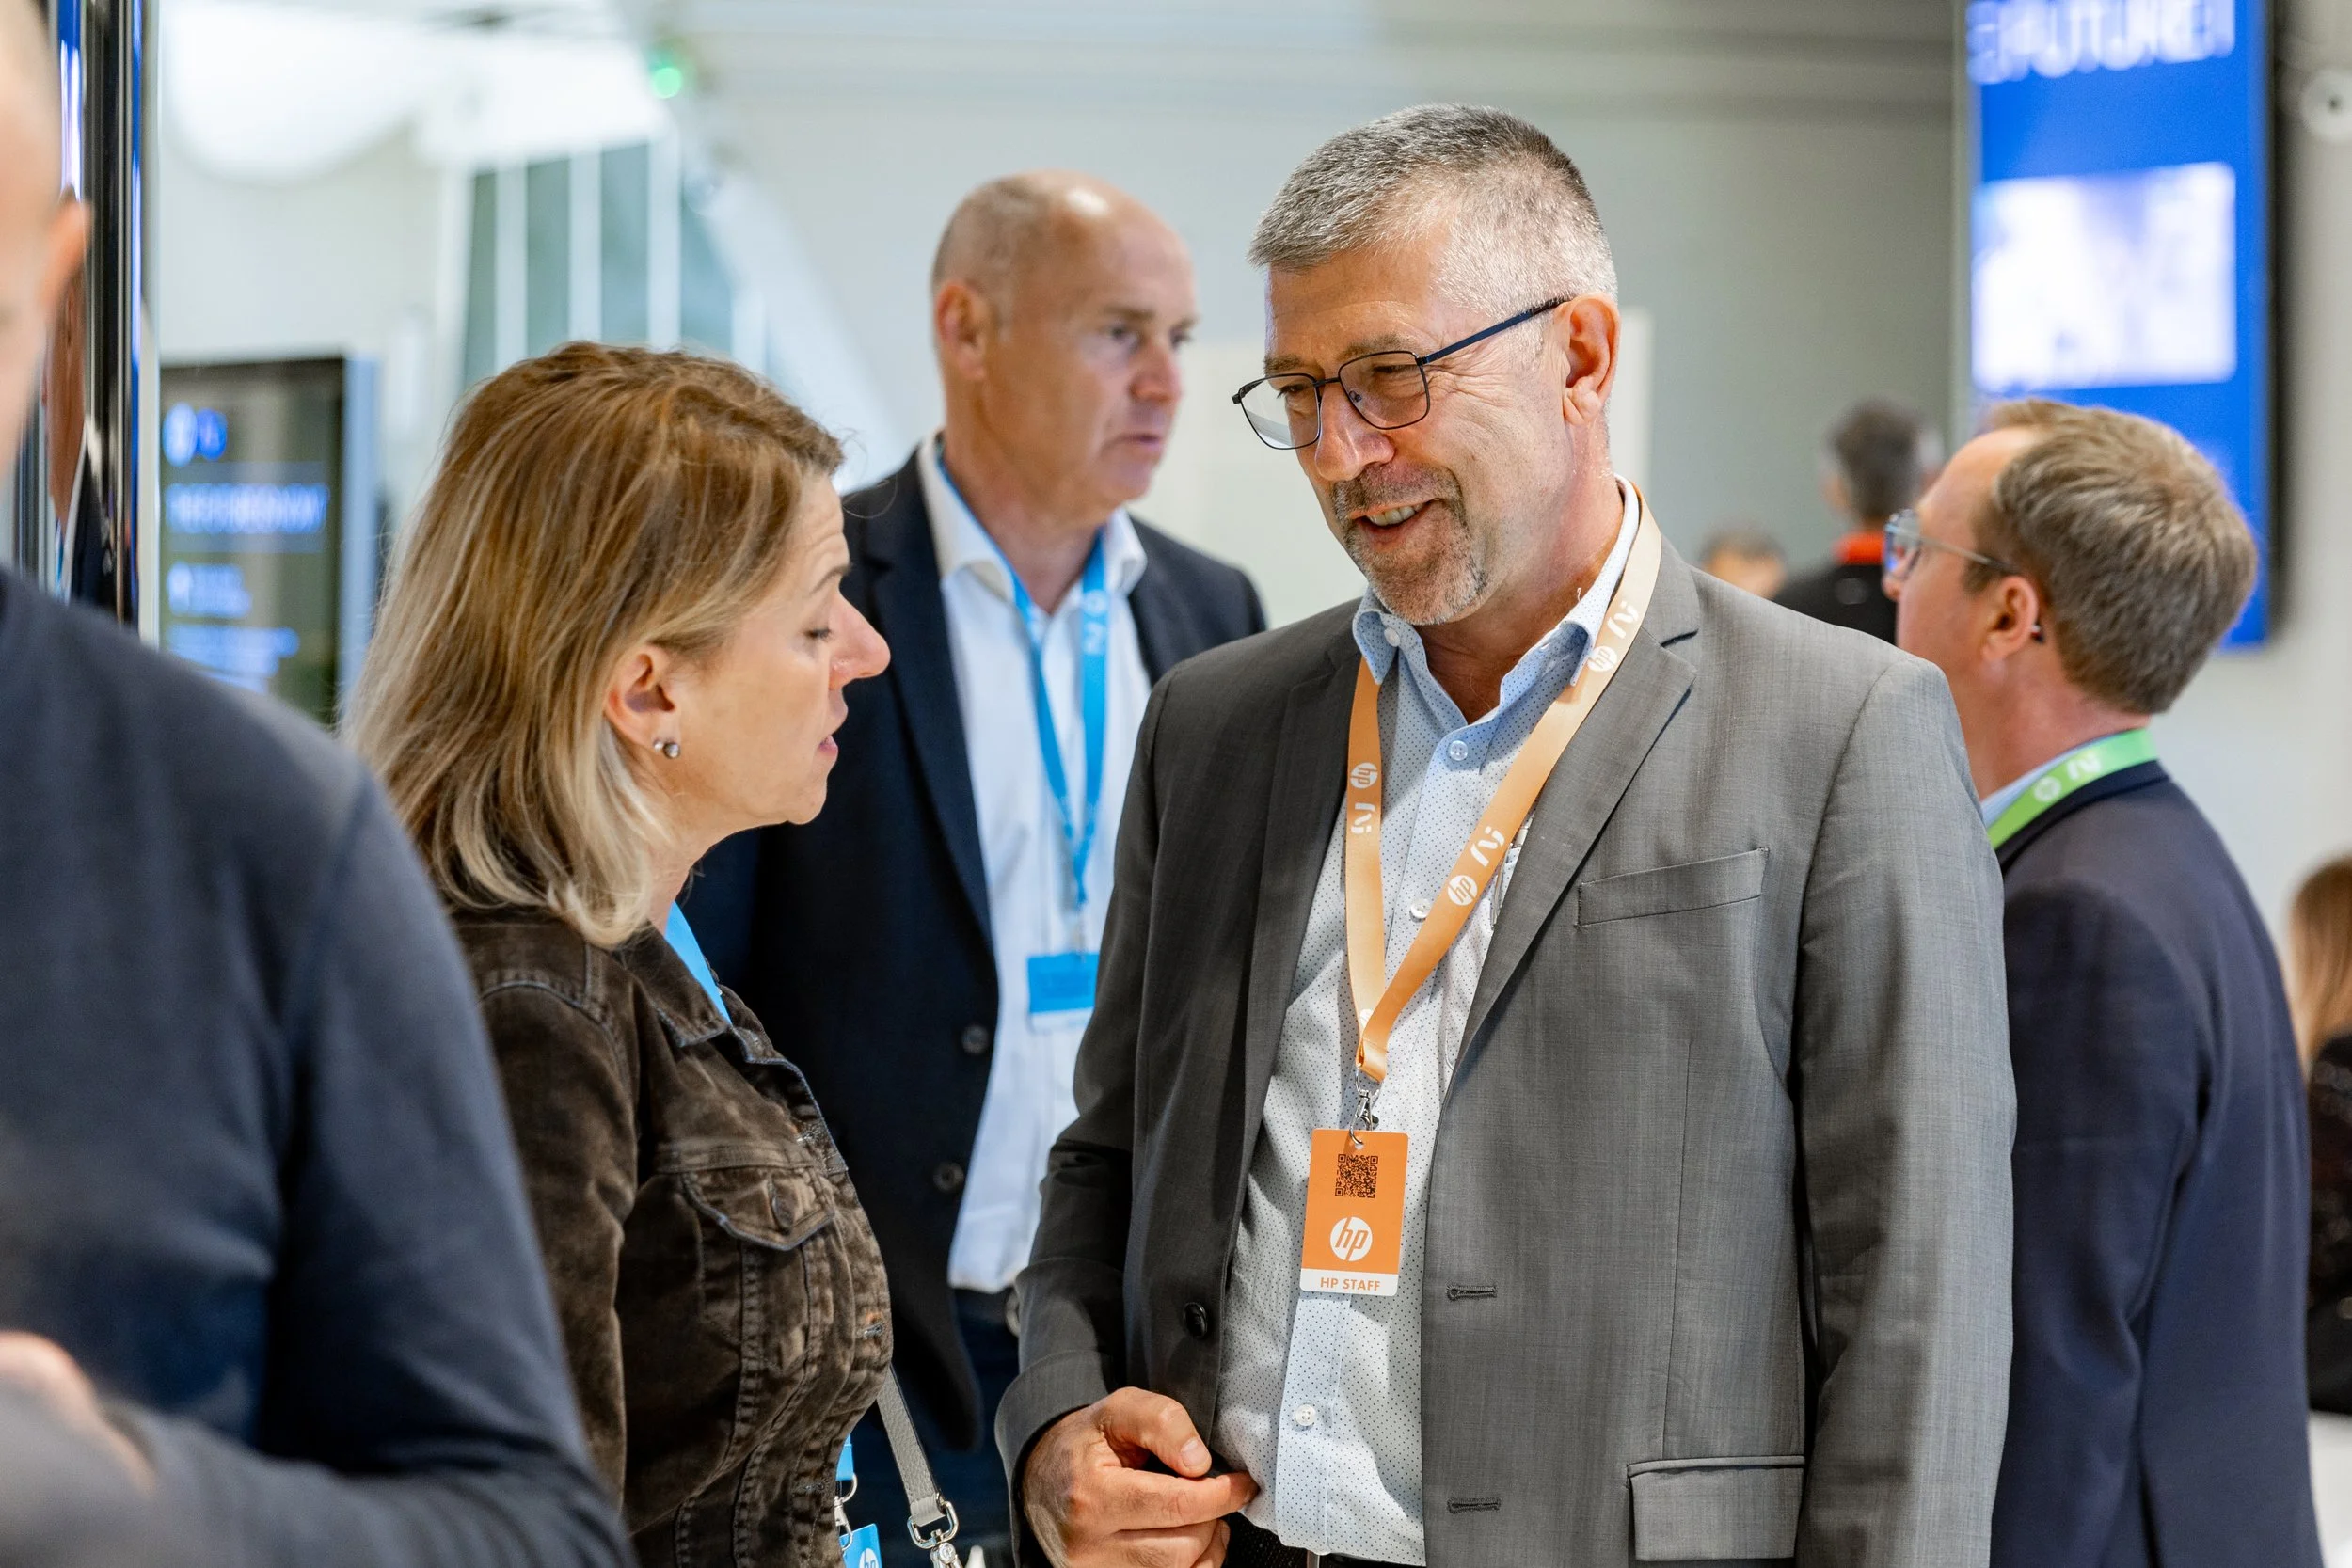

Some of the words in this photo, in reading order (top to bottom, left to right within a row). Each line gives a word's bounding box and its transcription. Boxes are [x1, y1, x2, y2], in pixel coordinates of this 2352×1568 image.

[1588, 647, 1616, 671] hp
[1350, 764, 1378, 787] hp
[1449, 876, 1476, 905] hp
[1333, 1217, 1370, 1261] hp
[1320, 1277, 1339, 1289] HP
[1343, 1278, 1381, 1291] STAFF
